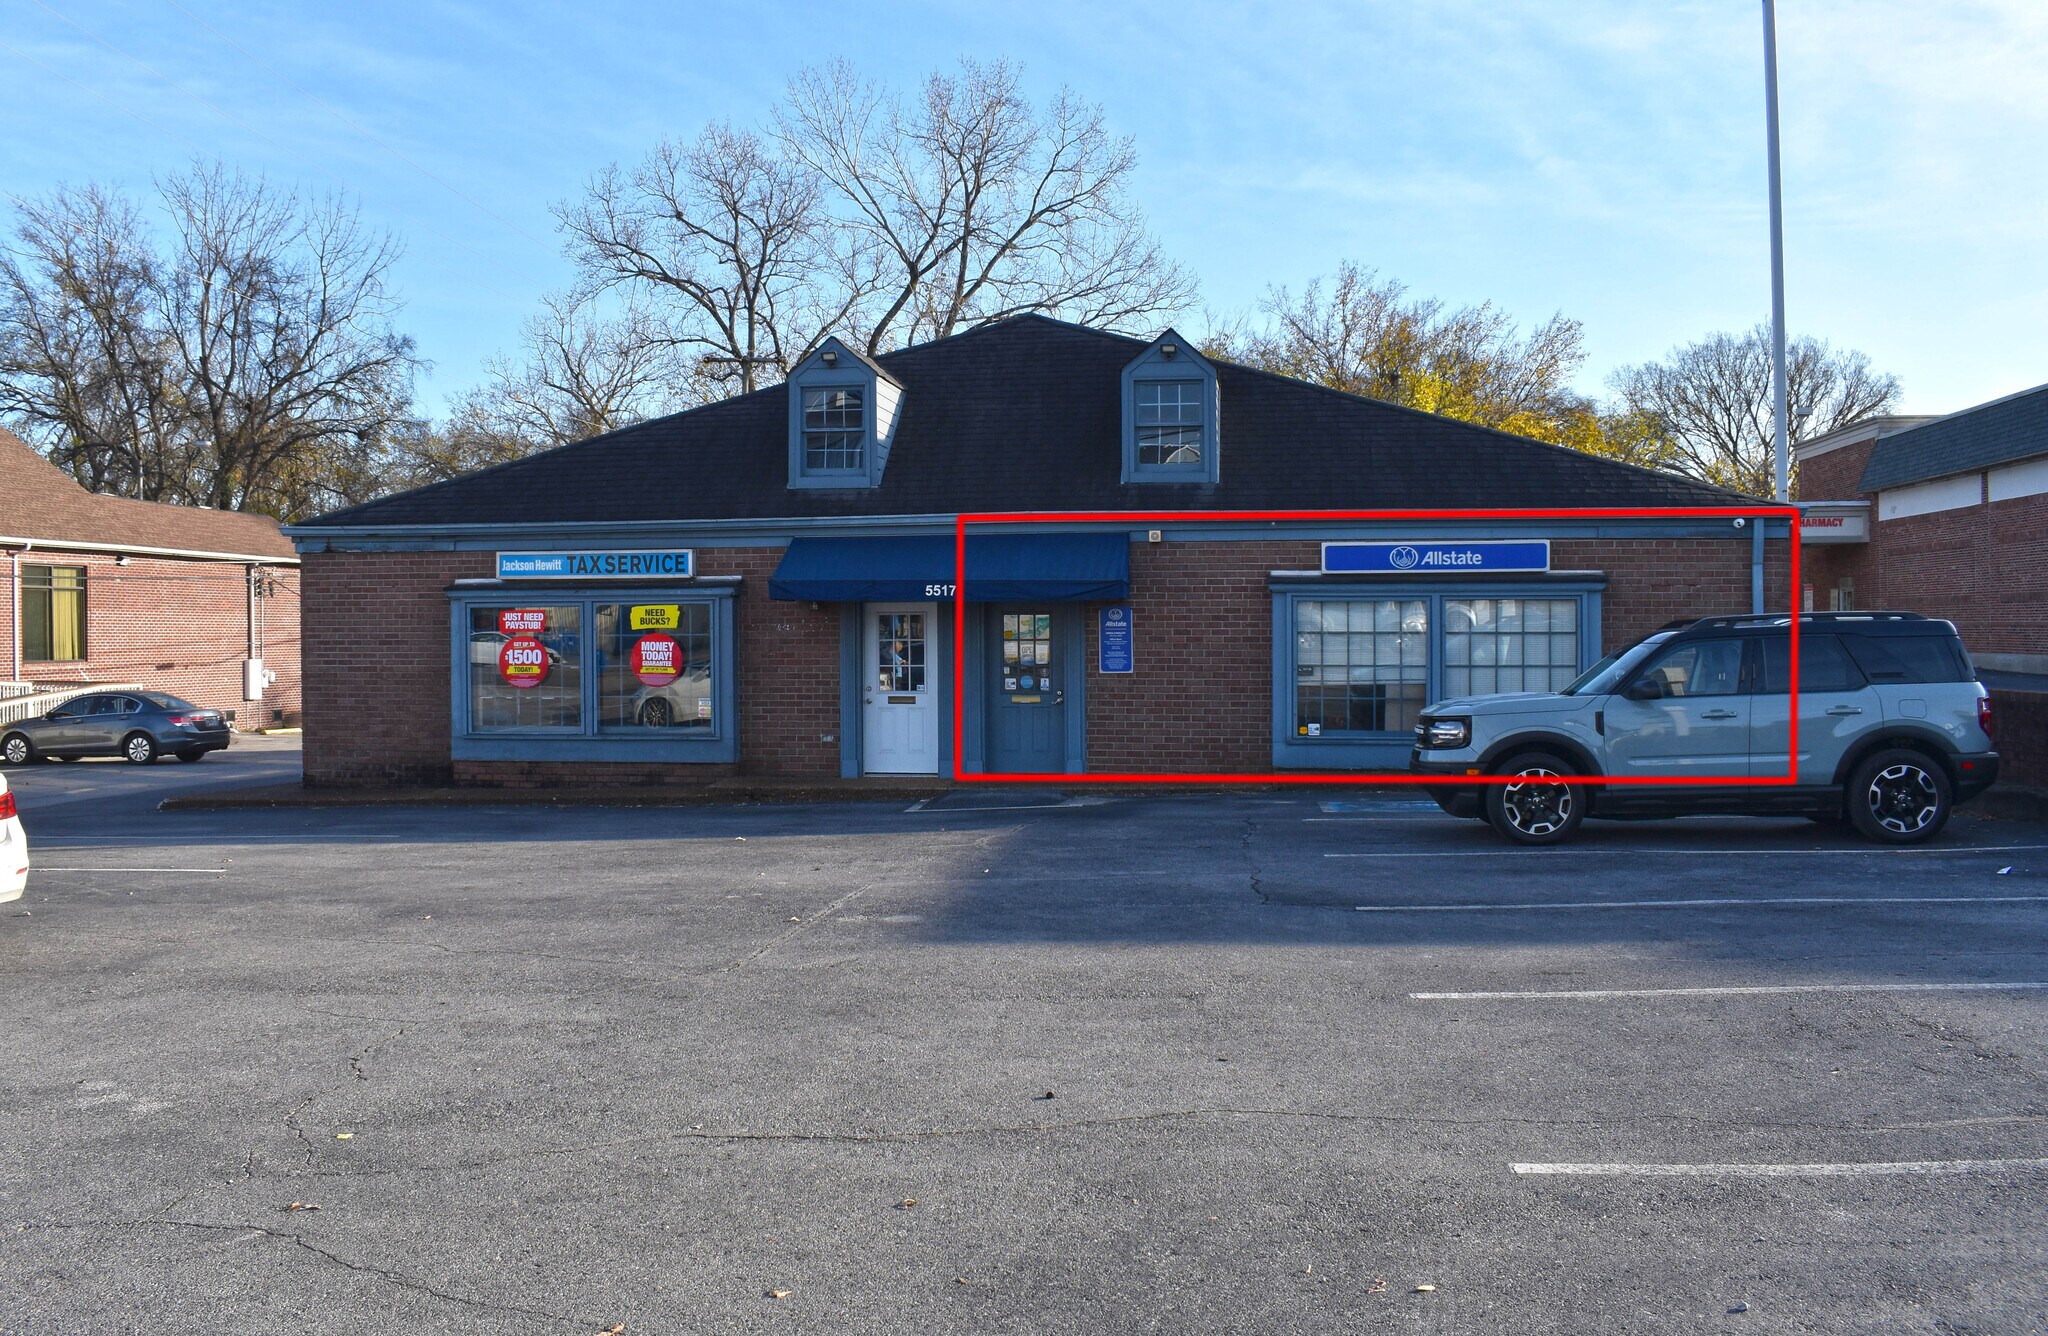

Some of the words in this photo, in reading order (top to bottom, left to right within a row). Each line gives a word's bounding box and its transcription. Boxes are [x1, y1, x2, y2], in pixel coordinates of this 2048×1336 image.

[1800, 518, 1844, 527] HARMACY
[1421, 551, 1482, 565] Allstate
[502, 560, 535, 571] Jackson
[535, 559, 562, 571] Hewitt
[567, 555, 602, 574] TAX
[605, 554, 686, 573] SERVICE
[925, 585, 957, 596] 5517
[505, 621, 541, 629] PAYSTUB!
[640, 617, 671, 625] BUCKS?
[641, 641, 674, 651] MONEY
[641, 651, 673, 660] TODAY!
